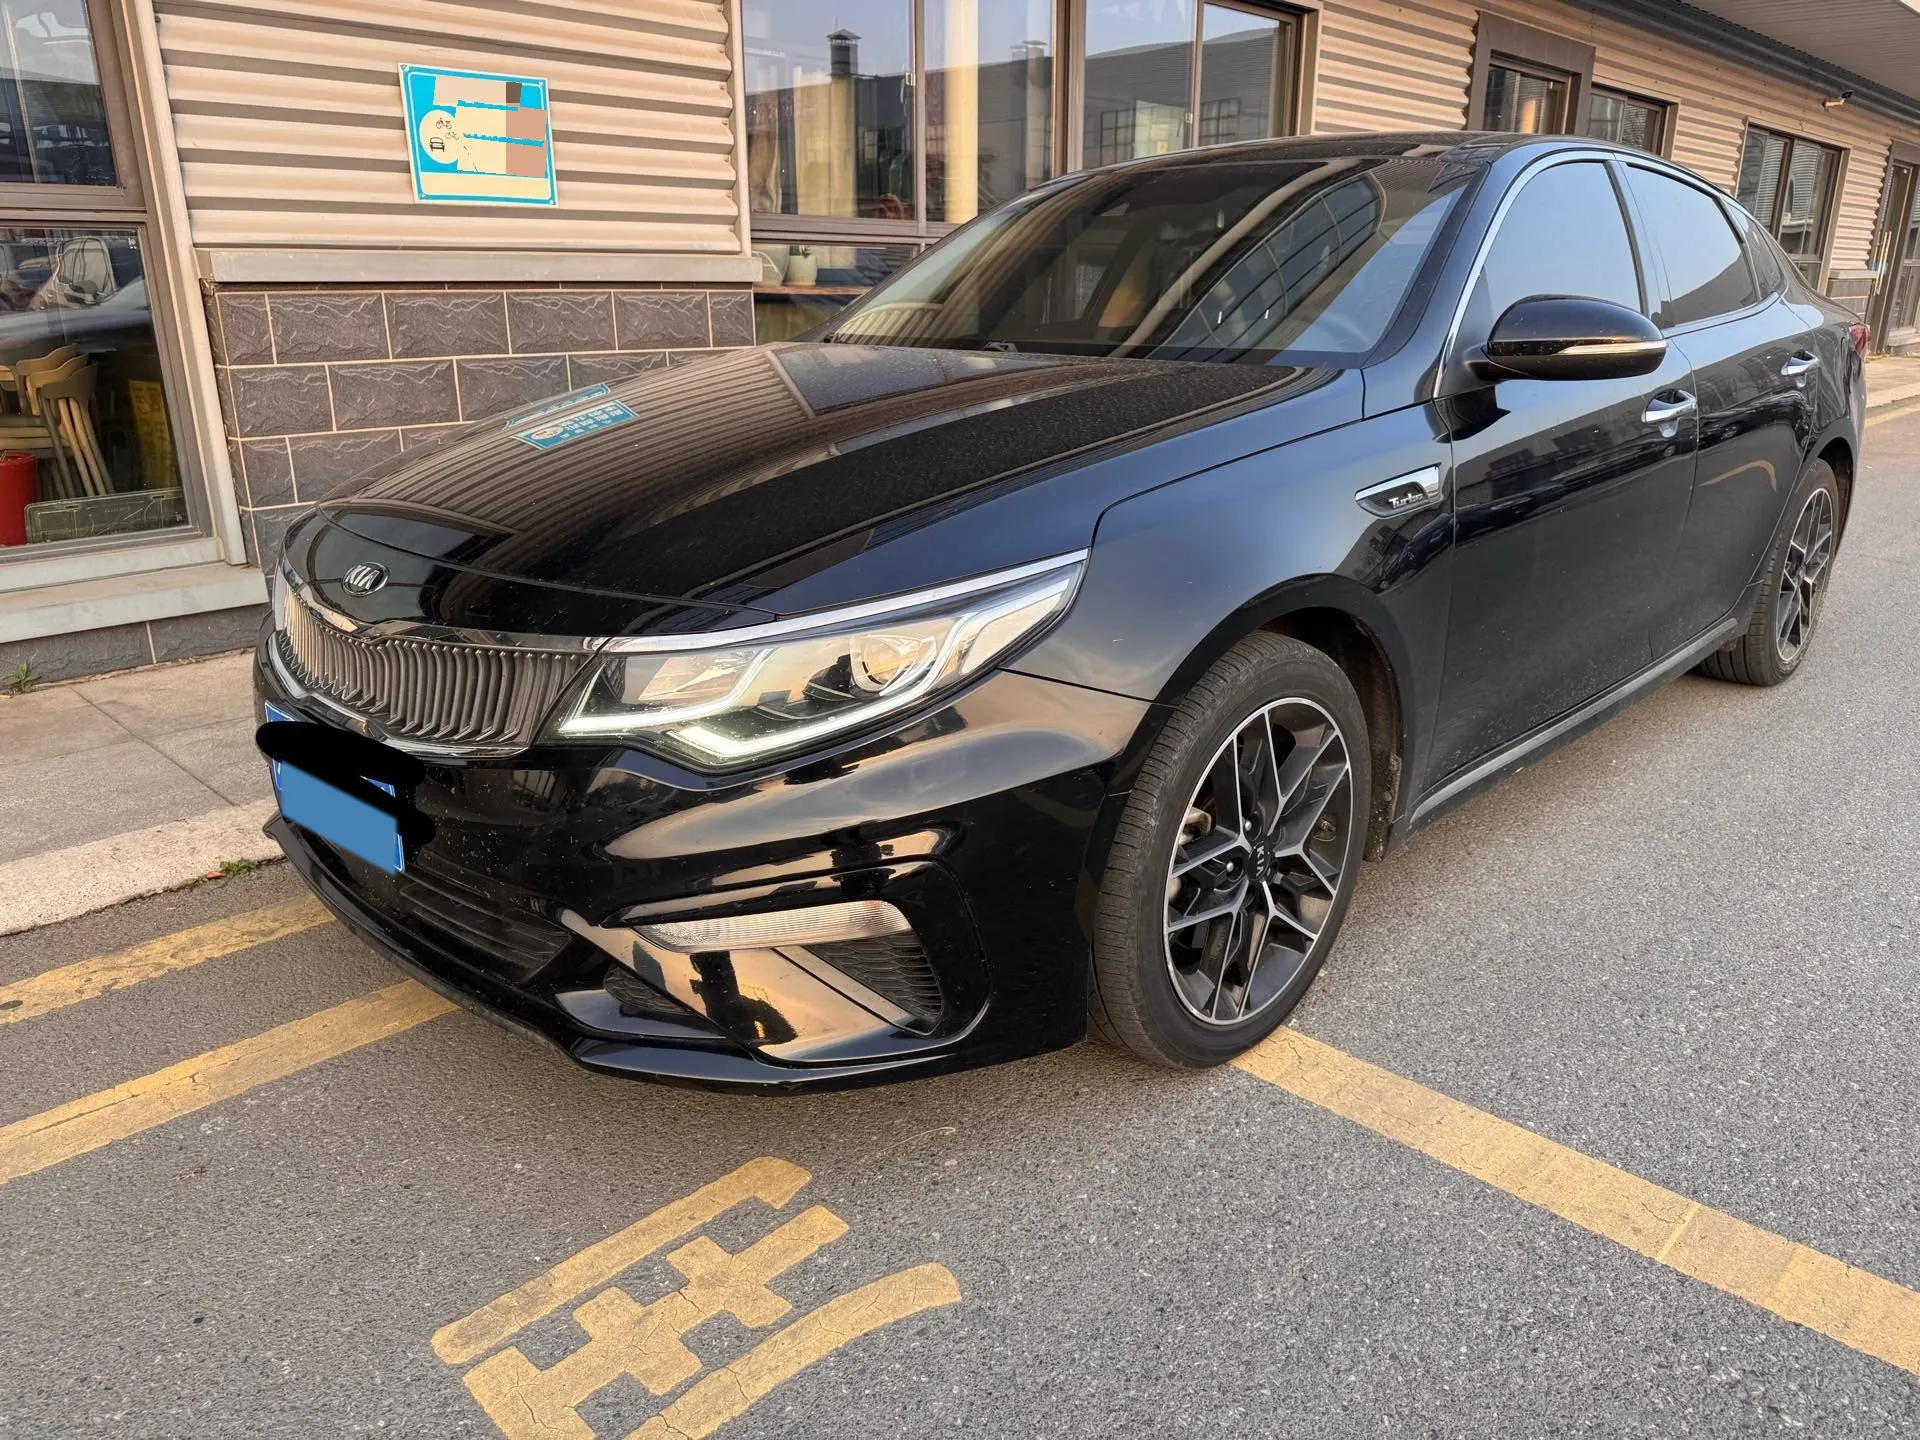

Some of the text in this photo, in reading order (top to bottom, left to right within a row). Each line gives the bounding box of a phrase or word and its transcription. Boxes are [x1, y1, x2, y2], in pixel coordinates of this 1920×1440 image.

[1388, 492, 1424, 509] Turbo
[344, 564, 381, 590] KIA
[430, 1155, 962, 1440] 用
